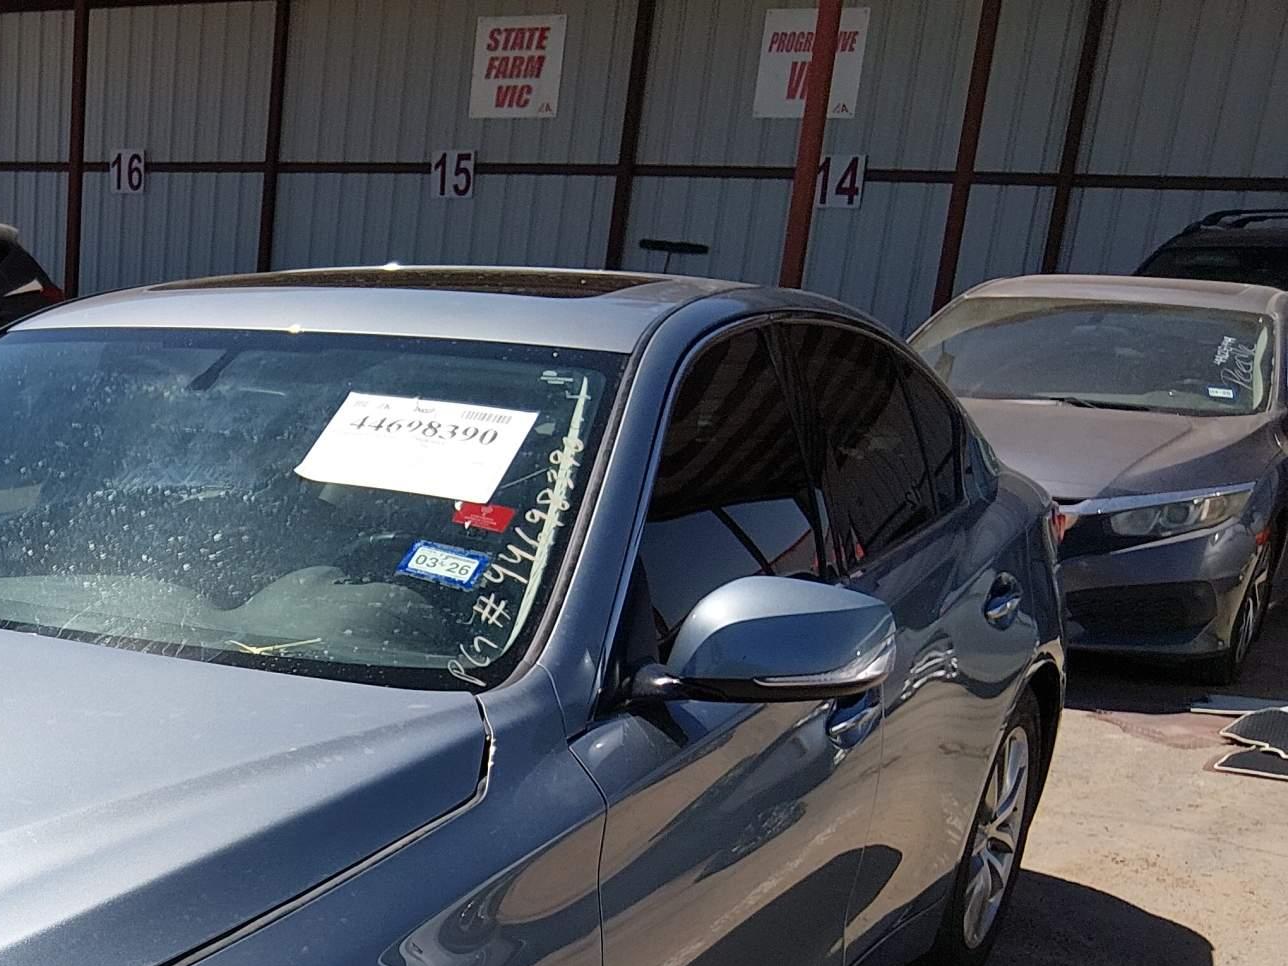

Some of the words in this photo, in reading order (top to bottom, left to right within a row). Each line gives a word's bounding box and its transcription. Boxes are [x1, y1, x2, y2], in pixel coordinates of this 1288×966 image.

[486, 26, 551, 51] STATE
[768, 31, 859, 53] PROGRIVE
[484, 55, 547, 80] FARM
[494, 84, 533, 108] VIC
[111, 152, 143, 192] 16
[434, 152, 472, 197] 15
[817, 156, 860, 206] 14
[349, 414, 499, 446] 44698390
